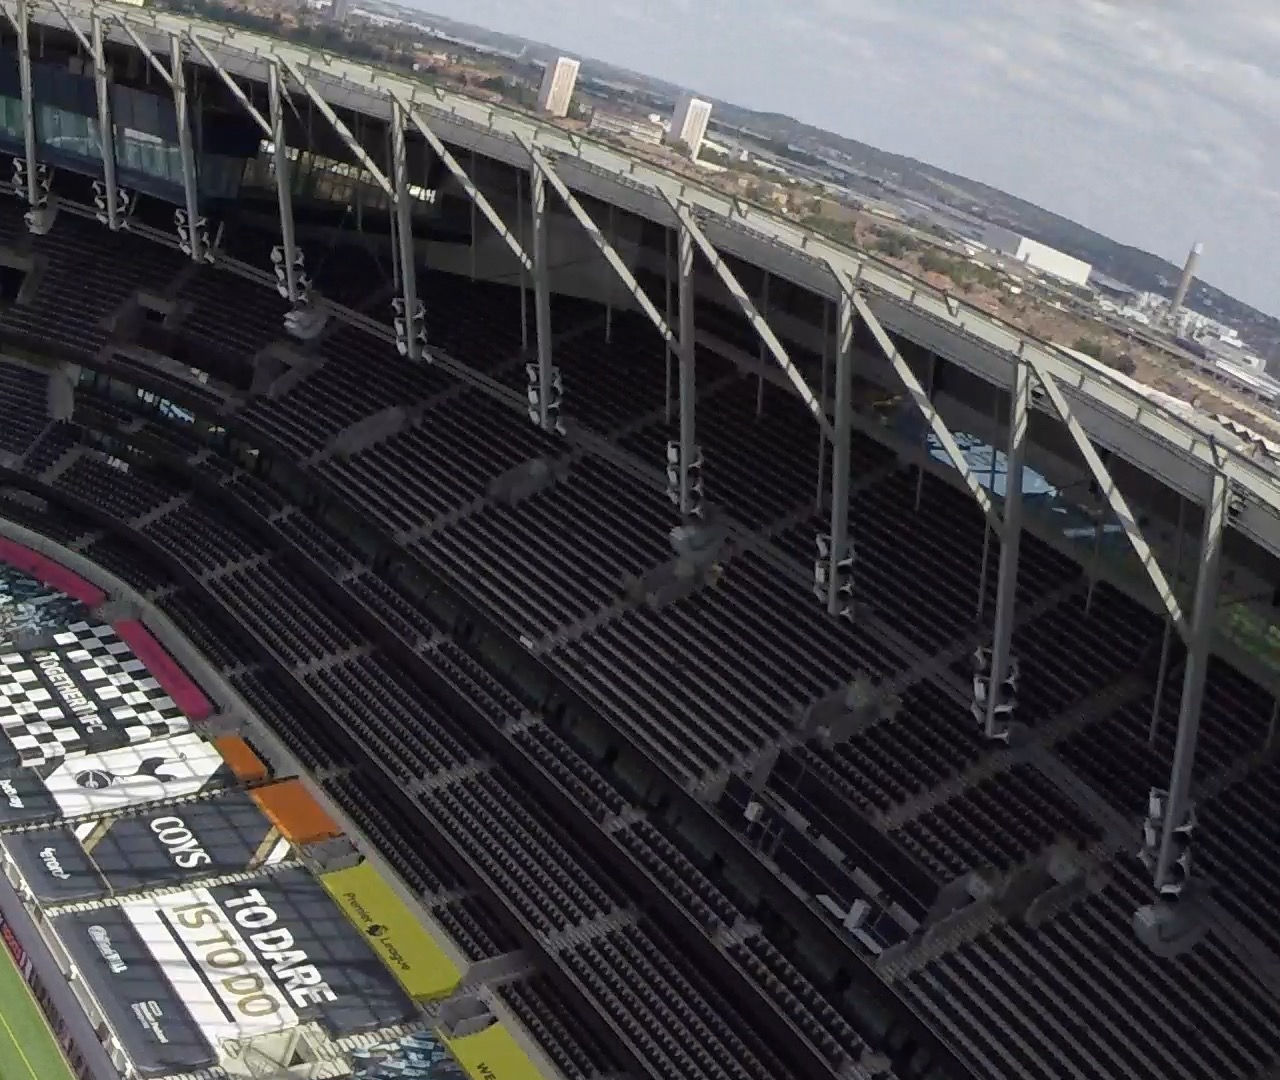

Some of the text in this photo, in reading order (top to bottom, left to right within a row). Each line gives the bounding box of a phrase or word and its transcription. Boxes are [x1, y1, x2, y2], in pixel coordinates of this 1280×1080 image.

[149, 816, 213, 869] COYS
[172, 901, 281, 1018] IS TO DO
[224, 888, 338, 1009] TO DARE
[343, 891, 412, 972] Premier League
